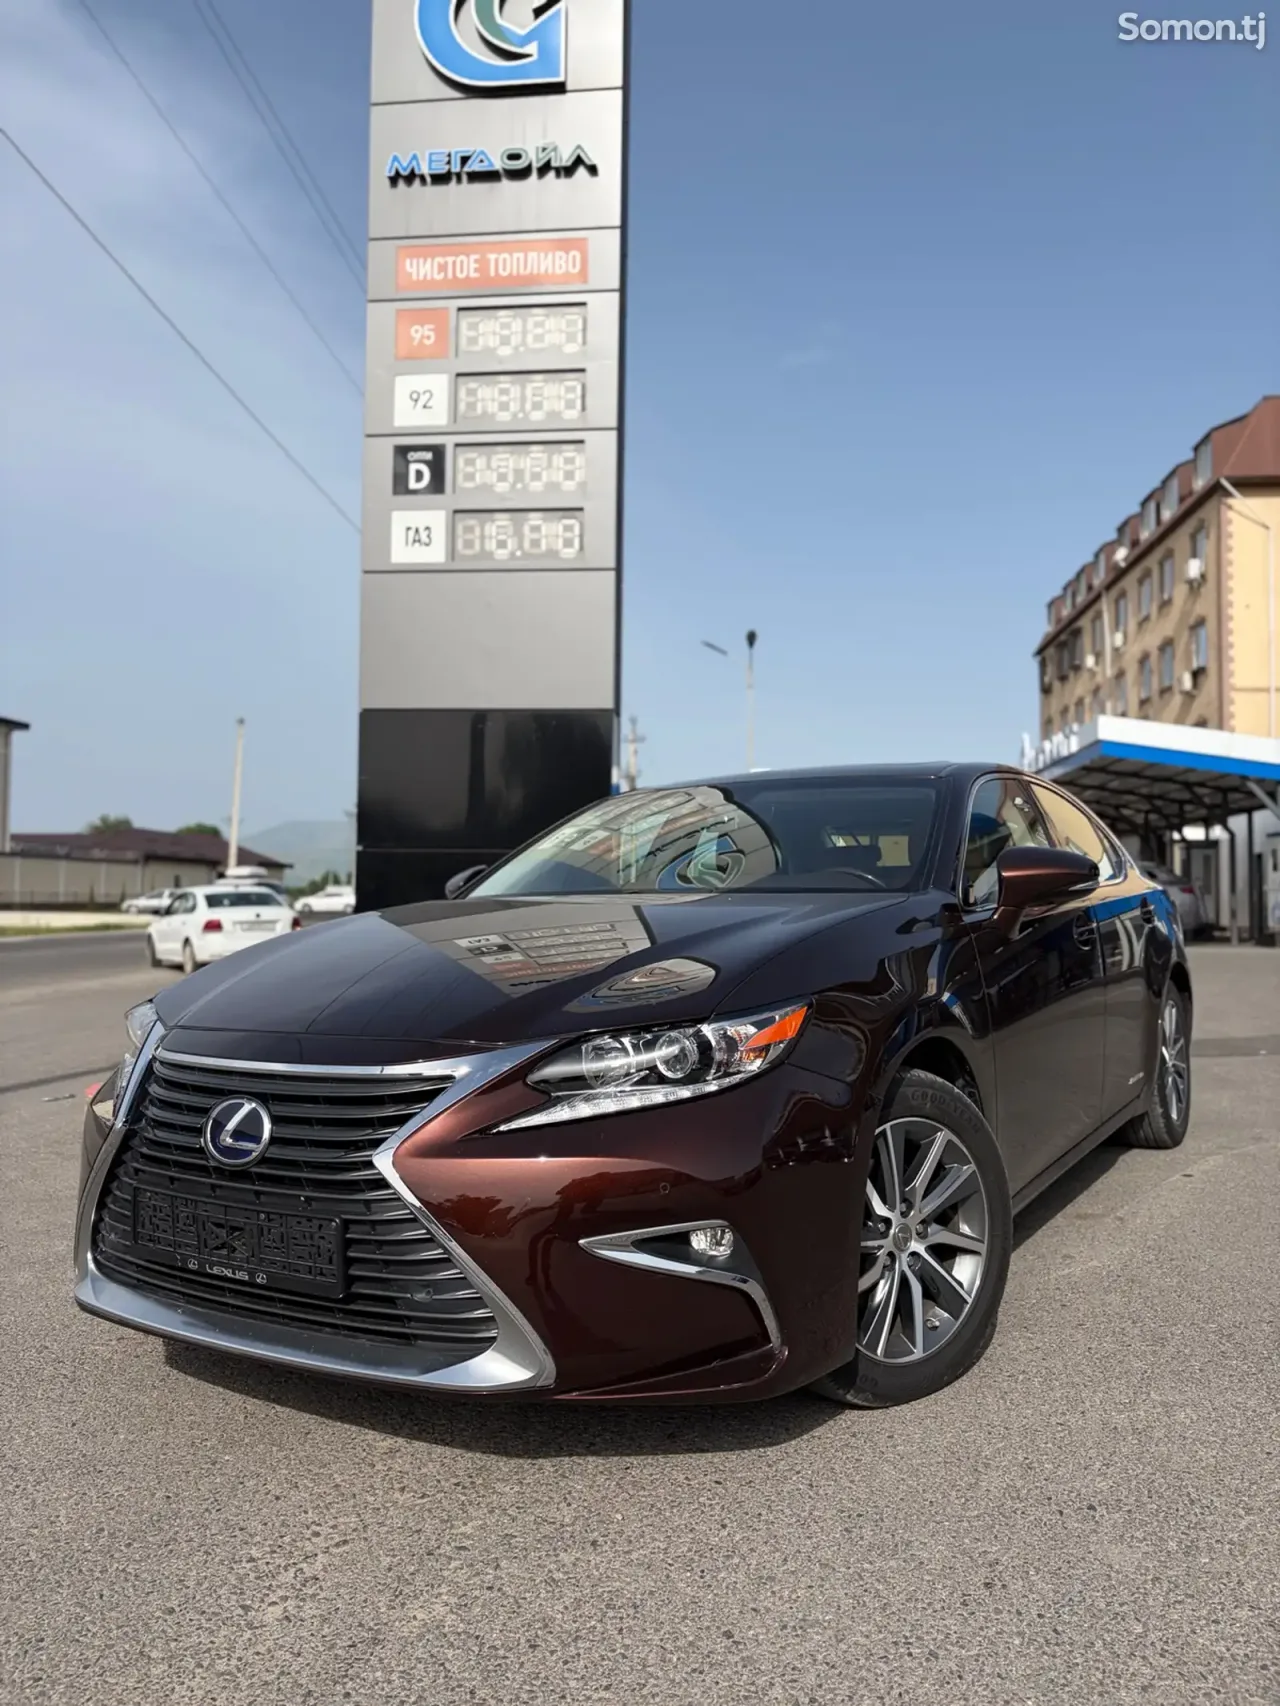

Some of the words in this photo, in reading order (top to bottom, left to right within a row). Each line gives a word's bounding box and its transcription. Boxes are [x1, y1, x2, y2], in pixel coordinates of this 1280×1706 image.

[405, 254, 480, 281] ЧИСТОЕ
[486, 250, 582, 277] ТОПЛИВО
[410, 324, 435, 345] 95
[409, 389, 434, 409] 92
[408, 462, 431, 490] D
[405, 526, 432, 547] ГАЗ
[911, 1090, 946, 1106] GOOD
[206, 1264, 249, 1280] LEXUS
